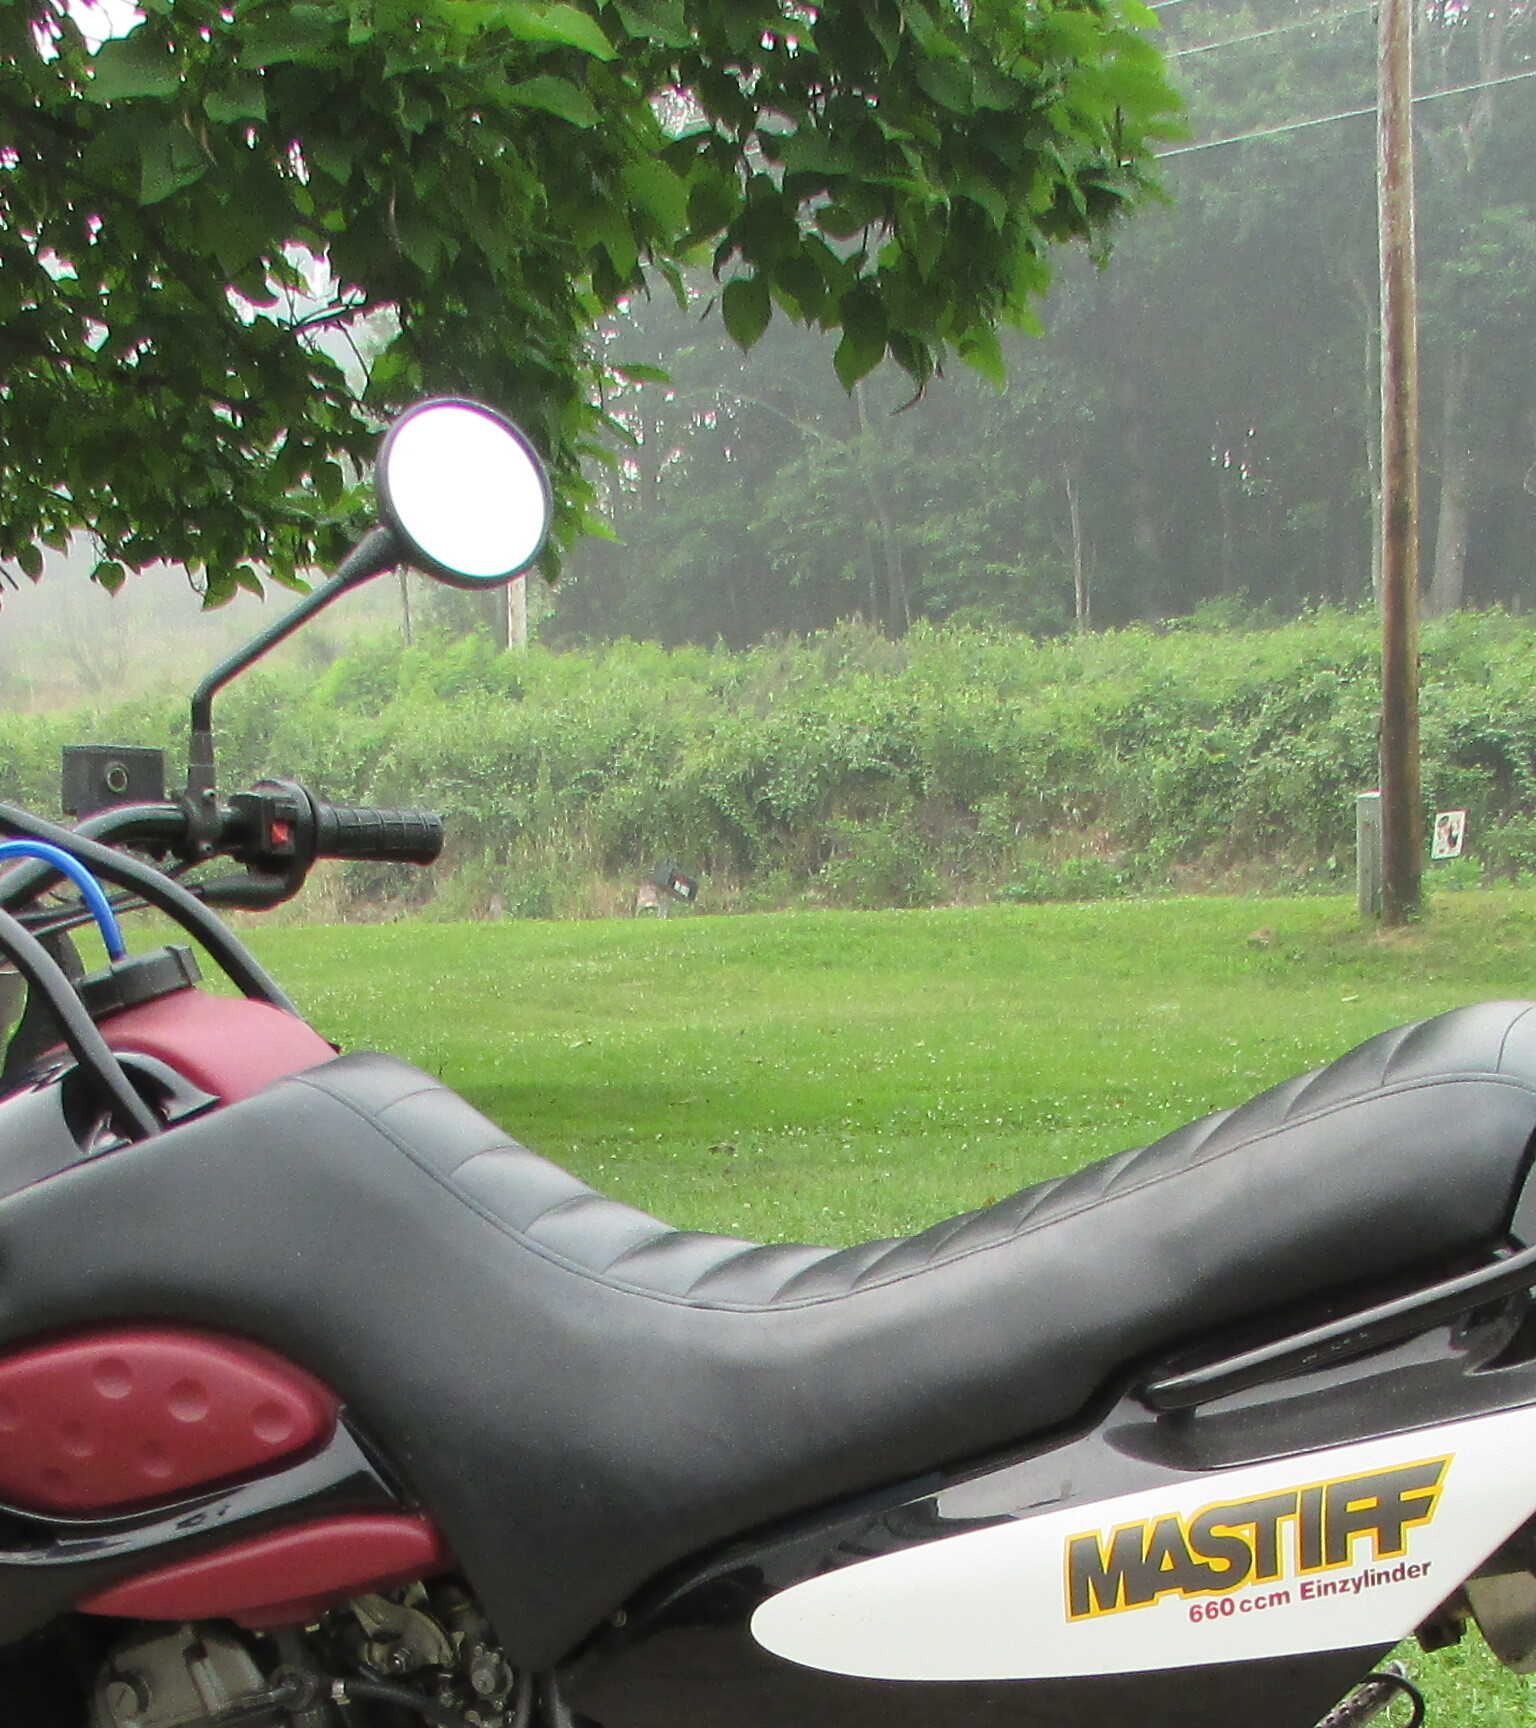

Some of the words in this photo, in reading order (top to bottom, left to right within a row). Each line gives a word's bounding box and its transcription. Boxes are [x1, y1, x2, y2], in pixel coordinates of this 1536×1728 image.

[1065, 1453, 1455, 1622] MASTIFF
[1188, 1597, 1235, 1624] 660
[1239, 1588, 1291, 1614] ccm
[1300, 1560, 1433, 1602] Einzylinder
